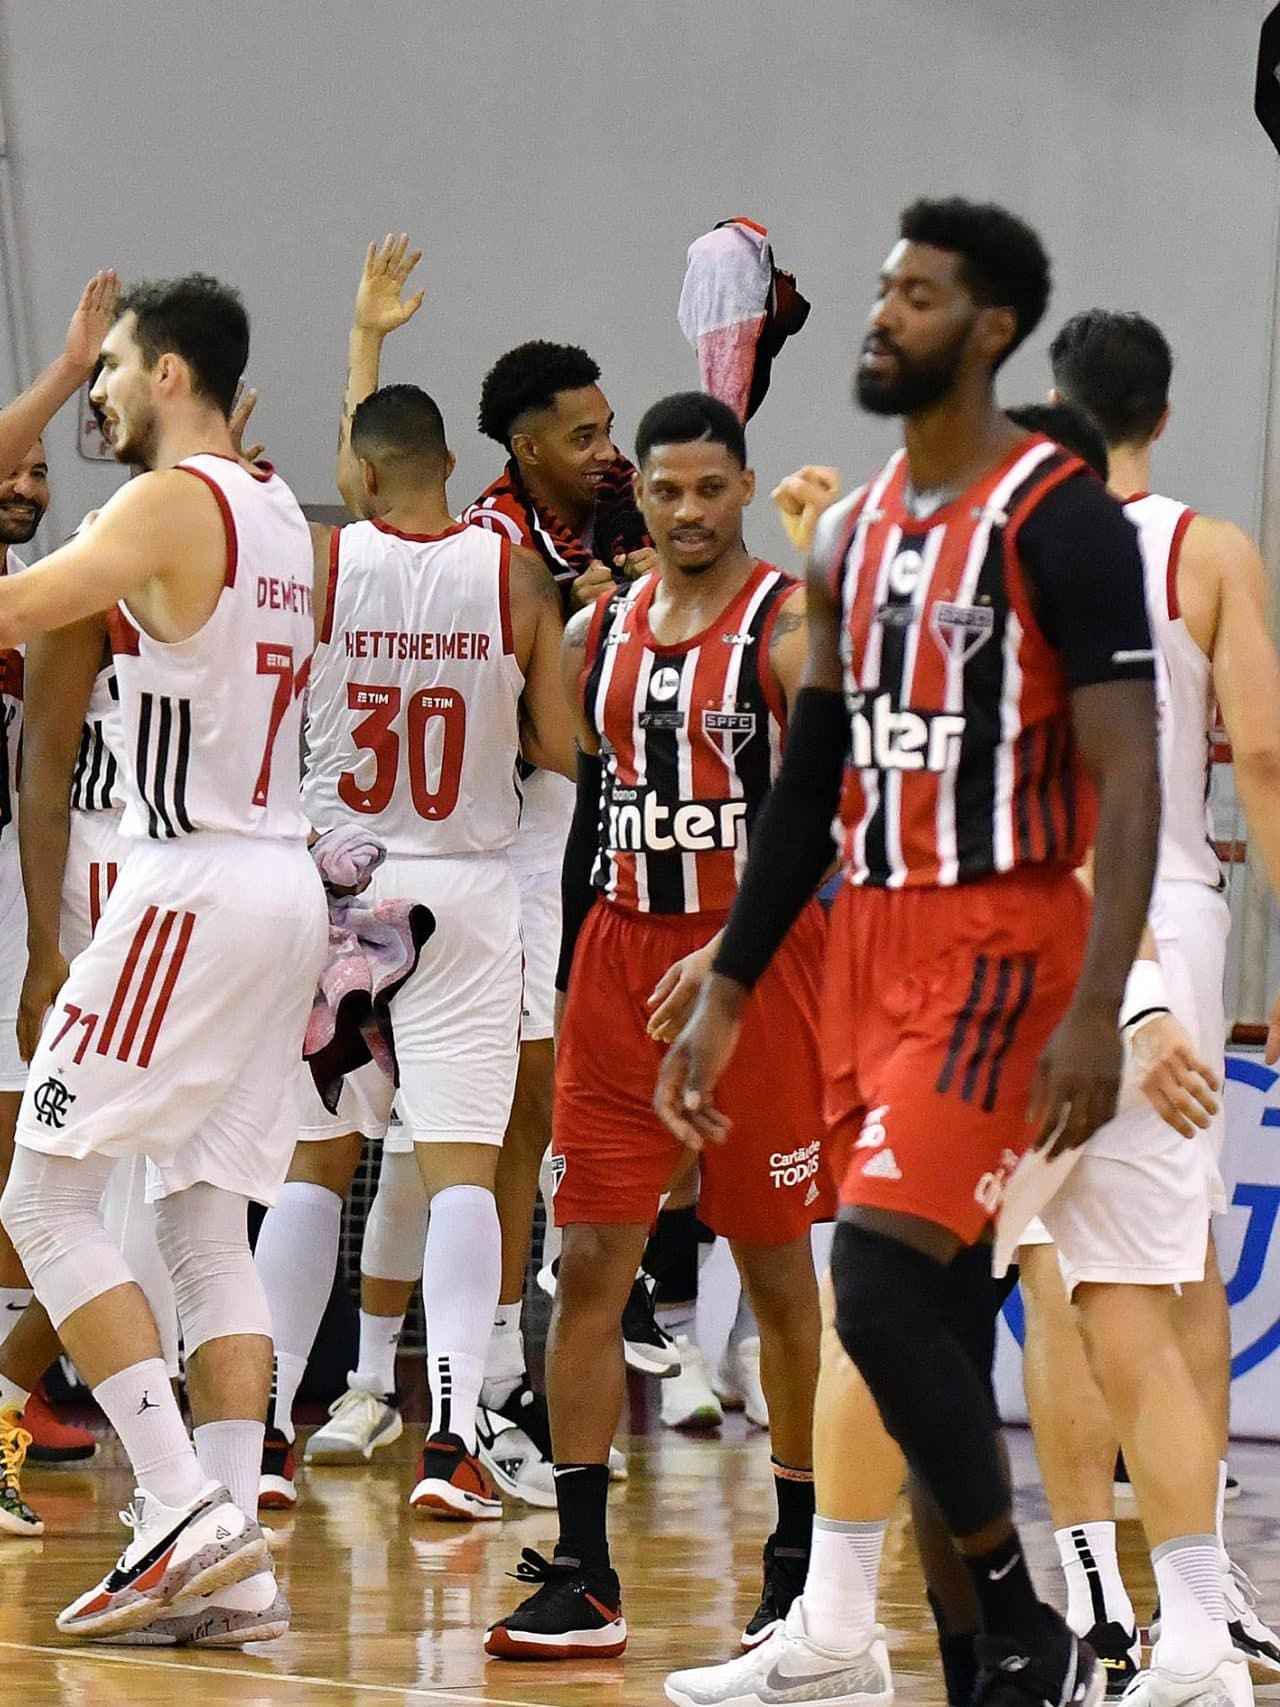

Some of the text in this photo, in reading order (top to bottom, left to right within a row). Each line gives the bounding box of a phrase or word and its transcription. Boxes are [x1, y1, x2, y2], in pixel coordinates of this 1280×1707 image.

[345, 630, 490, 661] HETTSHEIMEIR
[369, 693, 389, 704] TIM
[433, 697, 453, 708] TIM
[706, 714, 749, 728] SPFC
[251, 641, 315, 807] 7
[337, 681, 467, 821] 30
[608, 789, 748, 850] inter
[49, 1002, 99, 1065] 71
